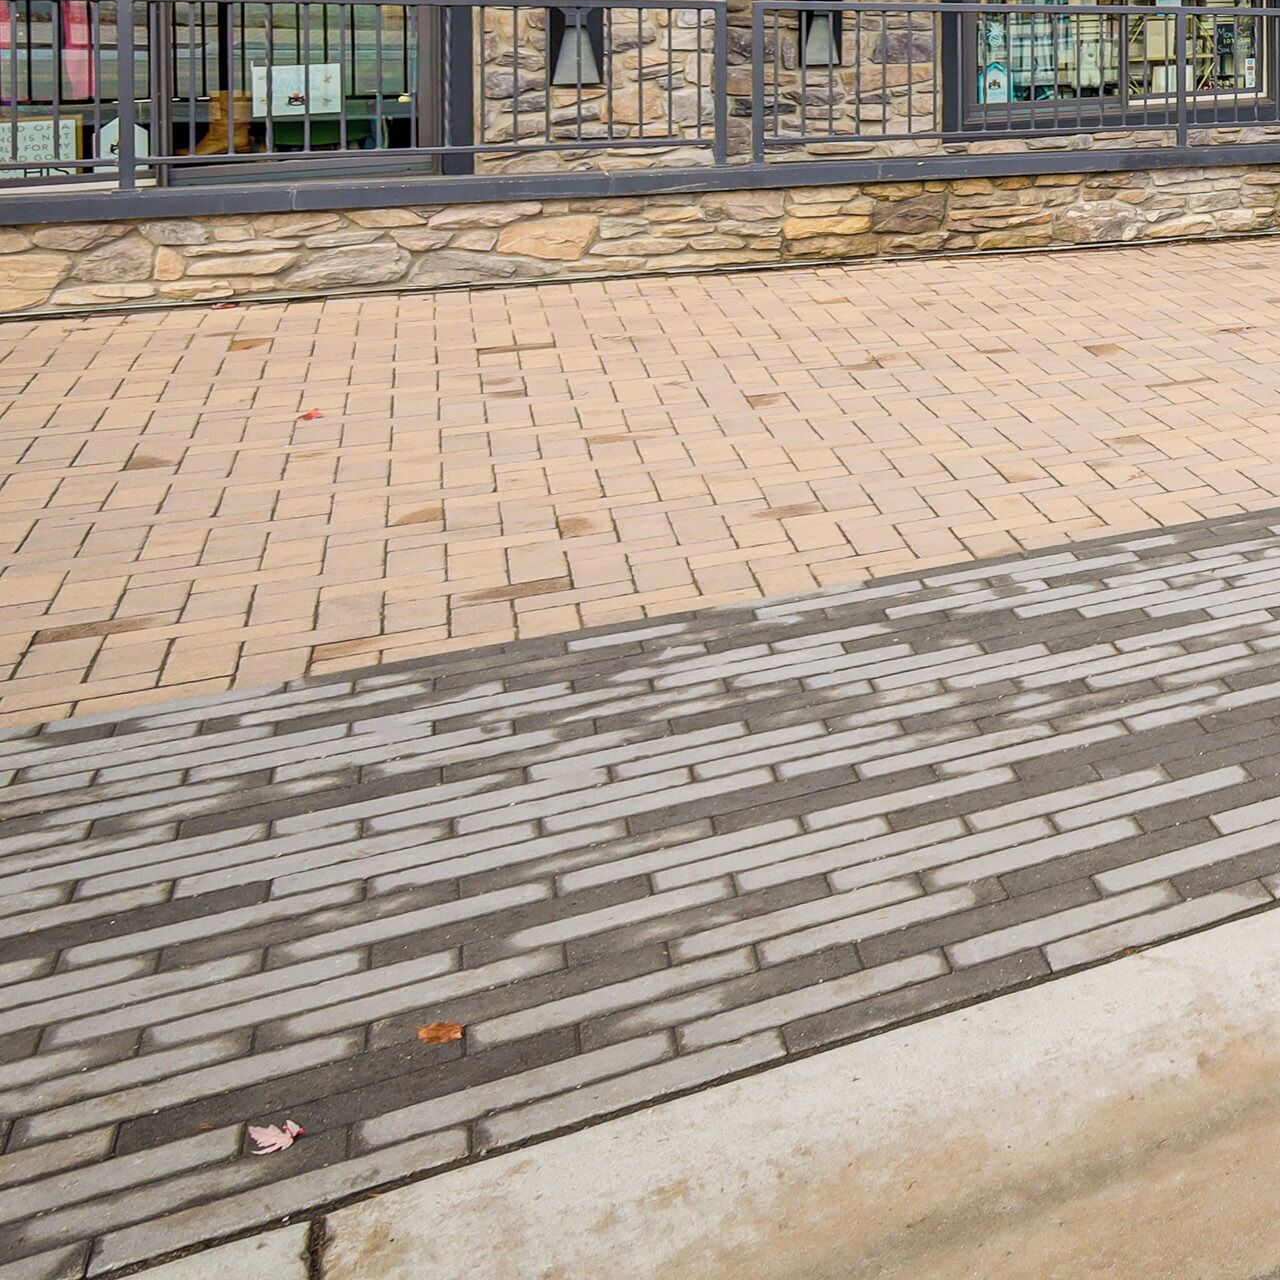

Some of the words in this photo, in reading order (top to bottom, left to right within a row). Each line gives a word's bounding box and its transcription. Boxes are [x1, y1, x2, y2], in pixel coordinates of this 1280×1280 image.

[42, 133, 71, 141] NT
[24, 144, 49, 152] FOR
[34, 153, 70, 161] GOS
